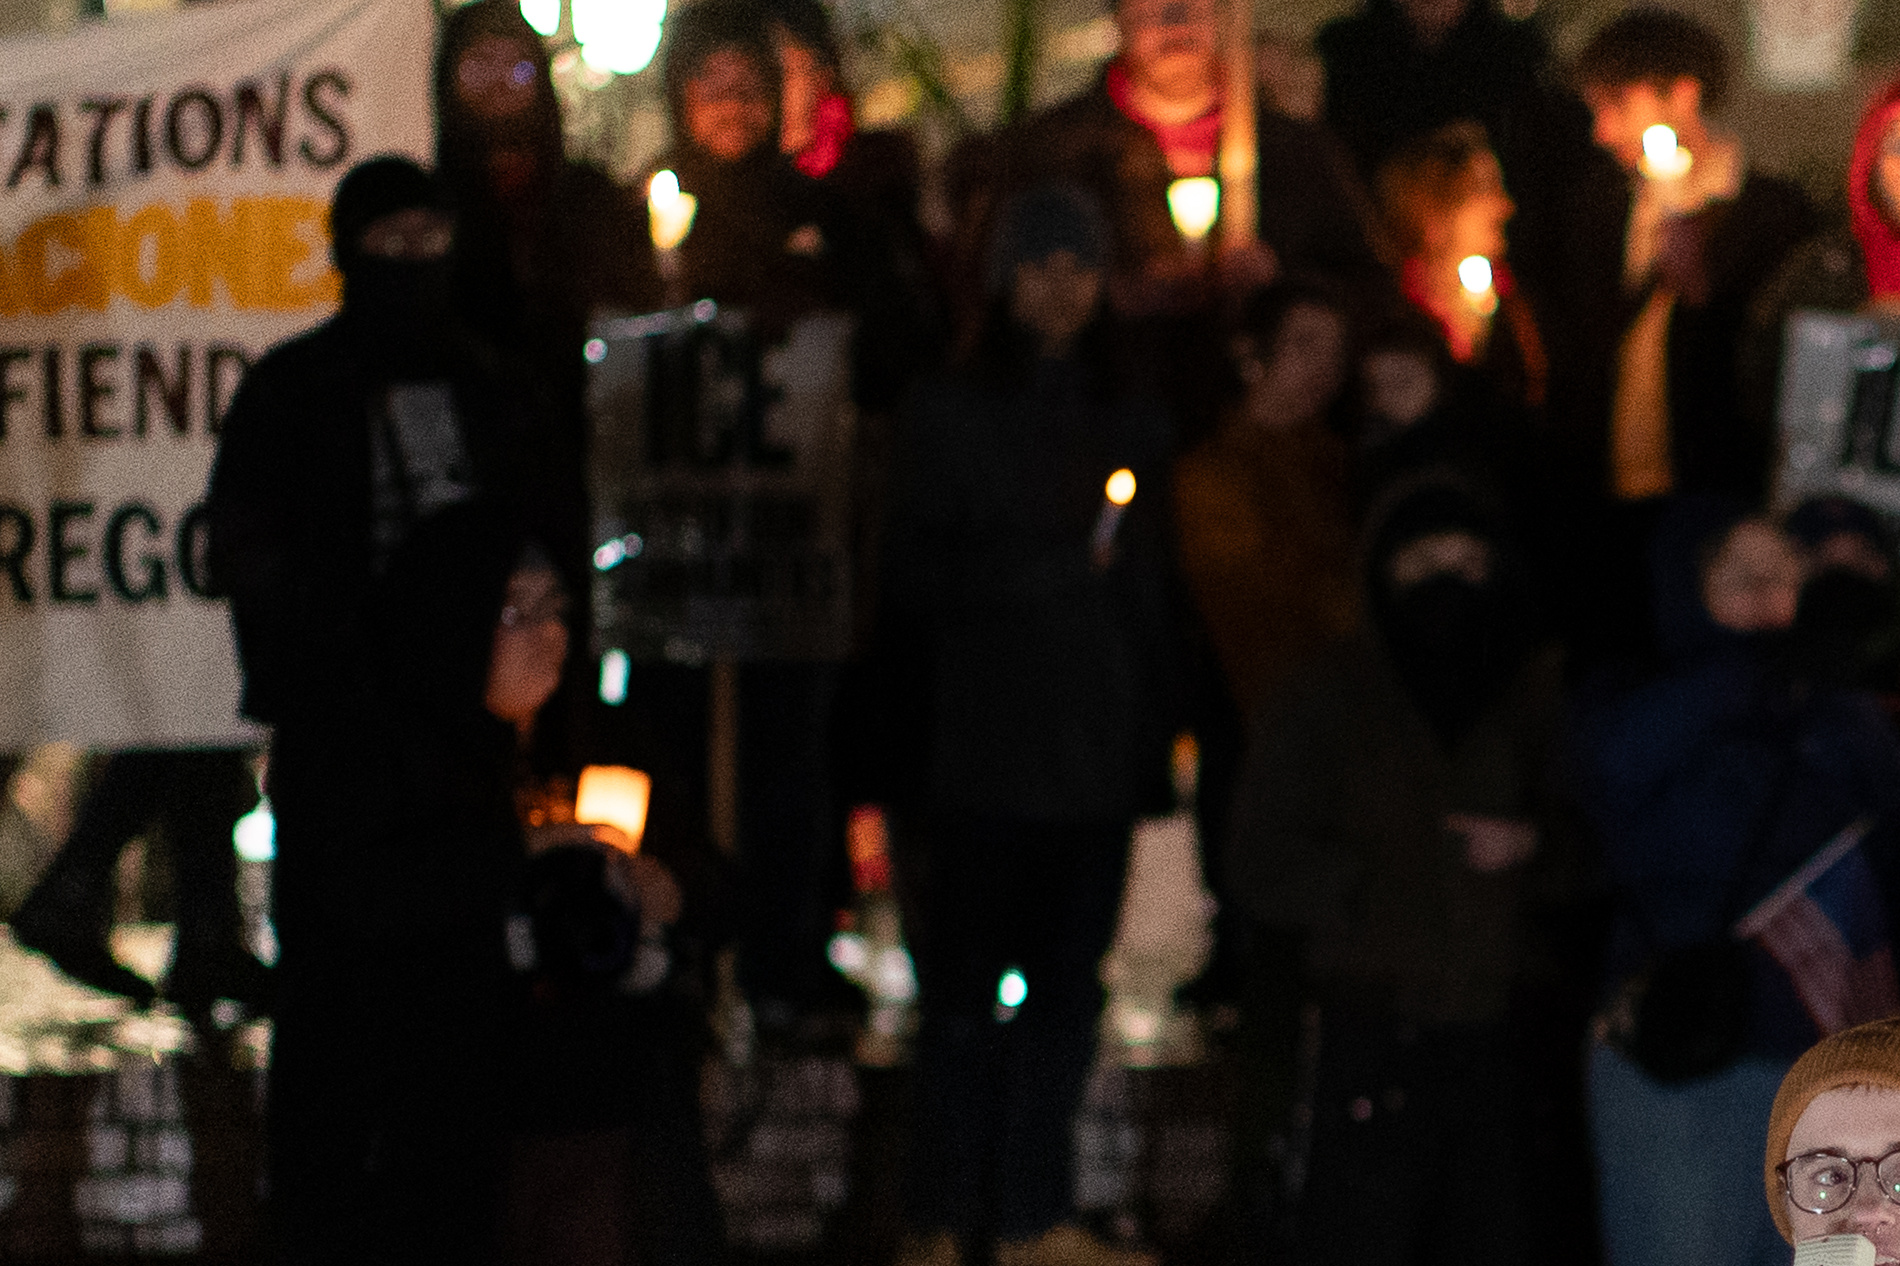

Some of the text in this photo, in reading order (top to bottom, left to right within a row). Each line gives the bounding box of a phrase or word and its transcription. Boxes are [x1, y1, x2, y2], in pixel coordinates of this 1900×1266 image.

[0, 70, 352, 192] ATIONS
[0, 196, 343, 318] CIONE
[0, 342, 253, 438] FIEND
[0, 503, 222, 602] REGO
